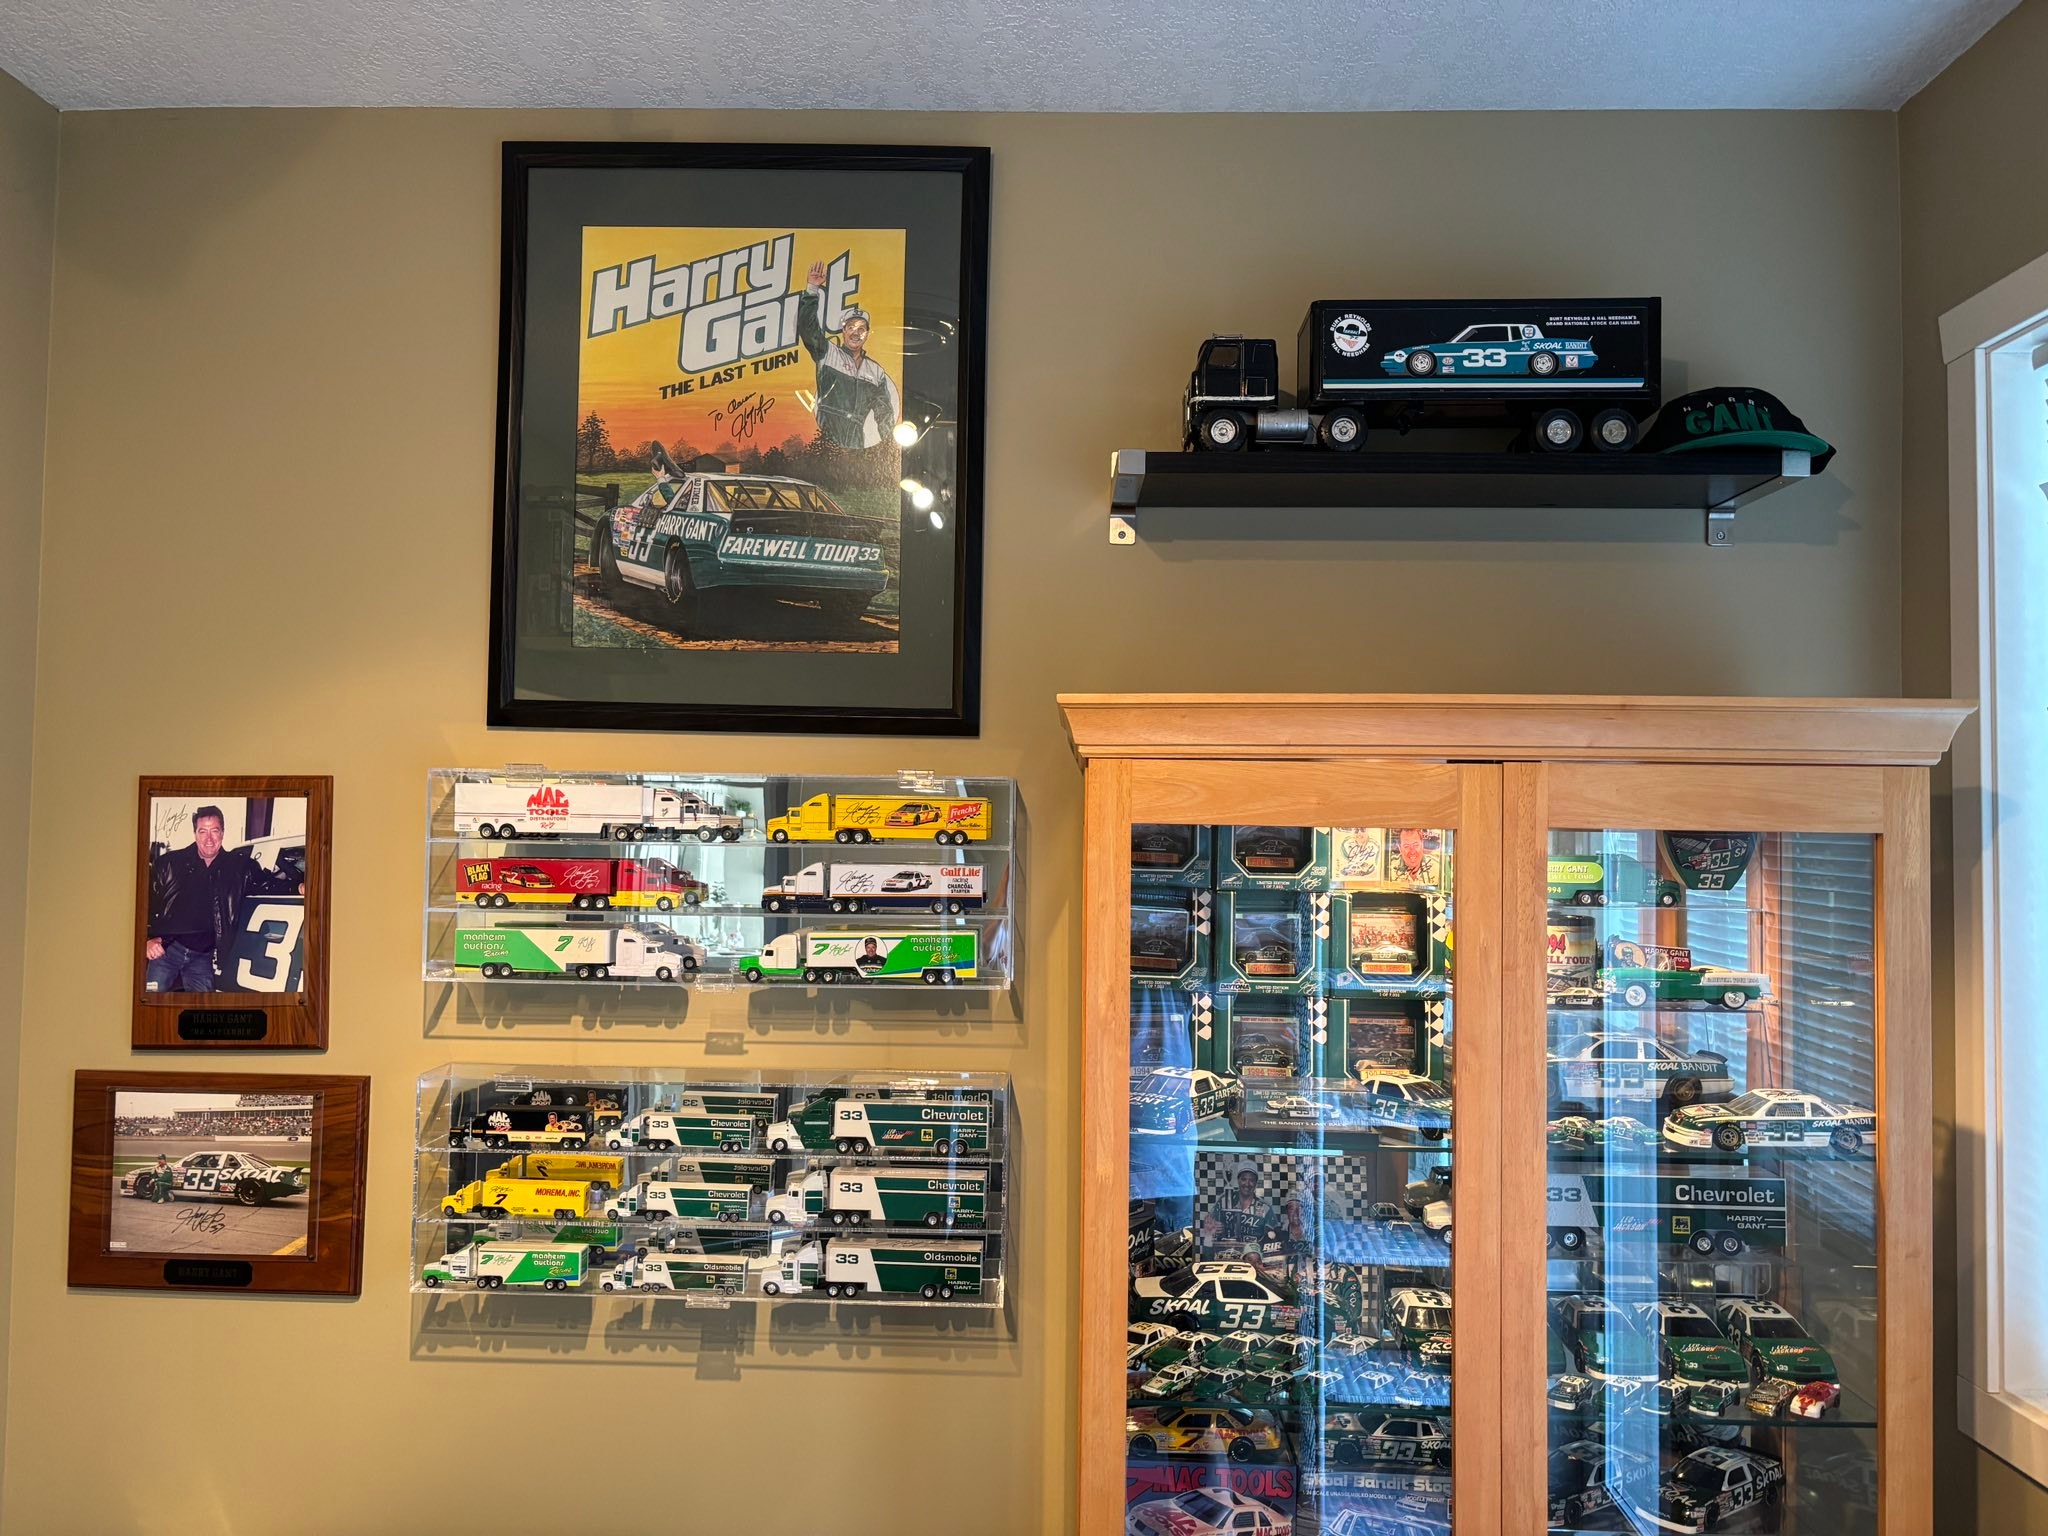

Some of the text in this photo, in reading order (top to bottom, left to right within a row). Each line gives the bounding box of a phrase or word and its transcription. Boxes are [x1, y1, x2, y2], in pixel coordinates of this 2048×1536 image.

[587, 232, 795, 338] Harry
[1344, 313, 1373, 331] REYNOLDS
[1342, 342, 1371, 357] NEEDHAM
[1462, 347, 1507, 367] 33
[659, 350, 799, 400] THE LAST TURN
[1685, 402, 1775, 434] GANT
[659, 514, 717, 542] HARRY GANT
[721, 535, 881, 562] FAREWELL TOUR 33
[526, 786, 569, 807] MAC
[526, 808, 569, 816] TOOLS
[1710, 851, 1731, 868] 33
[467, 862, 490, 875] BLACK
[940, 866, 981, 877] Gulf Lite
[470, 871, 489, 883] FLAG
[1697, 874, 1726, 889] 33
[481, 882, 502, 892] racing
[463, 933, 506, 941] manheim
[554, 935, 574, 951] 7
[463, 941, 504, 950] auctions
[813, 943, 830, 955] 7
[912, 943, 952, 952] auctions
[1669, 949, 1689, 957] GANT
[193, 1014, 253, 1023] HARRY GANT
[1133, 1067, 1150, 1075] 1994
[1647, 1062, 1718, 1073] SKOAL BANDIT
[1199, 1096, 1215, 1116] 33
[1374, 1098, 1399, 1120] 33
[488, 1111, 511, 1122] MAC
[840, 1110, 862, 1120] 33
[921, 1108, 984, 1121] Chevrolet
[652, 1120, 670, 1129] 33
[710, 1119, 749, 1128] Chevrolet
[1812, 1117, 1872, 1128] SKOAL BANDIT
[1566, 1127, 1577, 1136] 33
[184, 1169, 219, 1191] 33
[219, 1168, 281, 1184] SKOAL
[839, 1182, 863, 1193] 33
[927, 1180, 981, 1191] Chevrolet
[494, 1193, 508, 1205] 7
[649, 1191, 666, 1199] 33
[708, 1190, 746, 1199] Chevrolet
[1675, 1183, 1775, 1204] Chevrolet
[1726, 1214, 1764, 1222] HARRY
[1737, 1222, 1767, 1230] GANT
[480, 1254, 494, 1265] 7
[835, 1253, 859, 1264] 33
[924, 1252, 977, 1263] Oldsmobile
[645, 1264, 662, 1272] 33
[703, 1263, 742, 1271] Oldsmobile
[1150, 1298, 1210, 1315] SKOAL
[1219, 1304, 1266, 1330] 33
[1727, 1324, 1741, 1349] 33
[1179, 1429, 1205, 1448] 7
[1380, 1440, 1417, 1461] 33
[1152, 1465, 1206, 1493] MAC
[1215, 1467, 1294, 1499] TOOLS
[1353, 1475, 1409, 1490] Bandit
[1413, 1476, 1452, 1492] Stoc
[1733, 1483, 1754, 1508] 33
